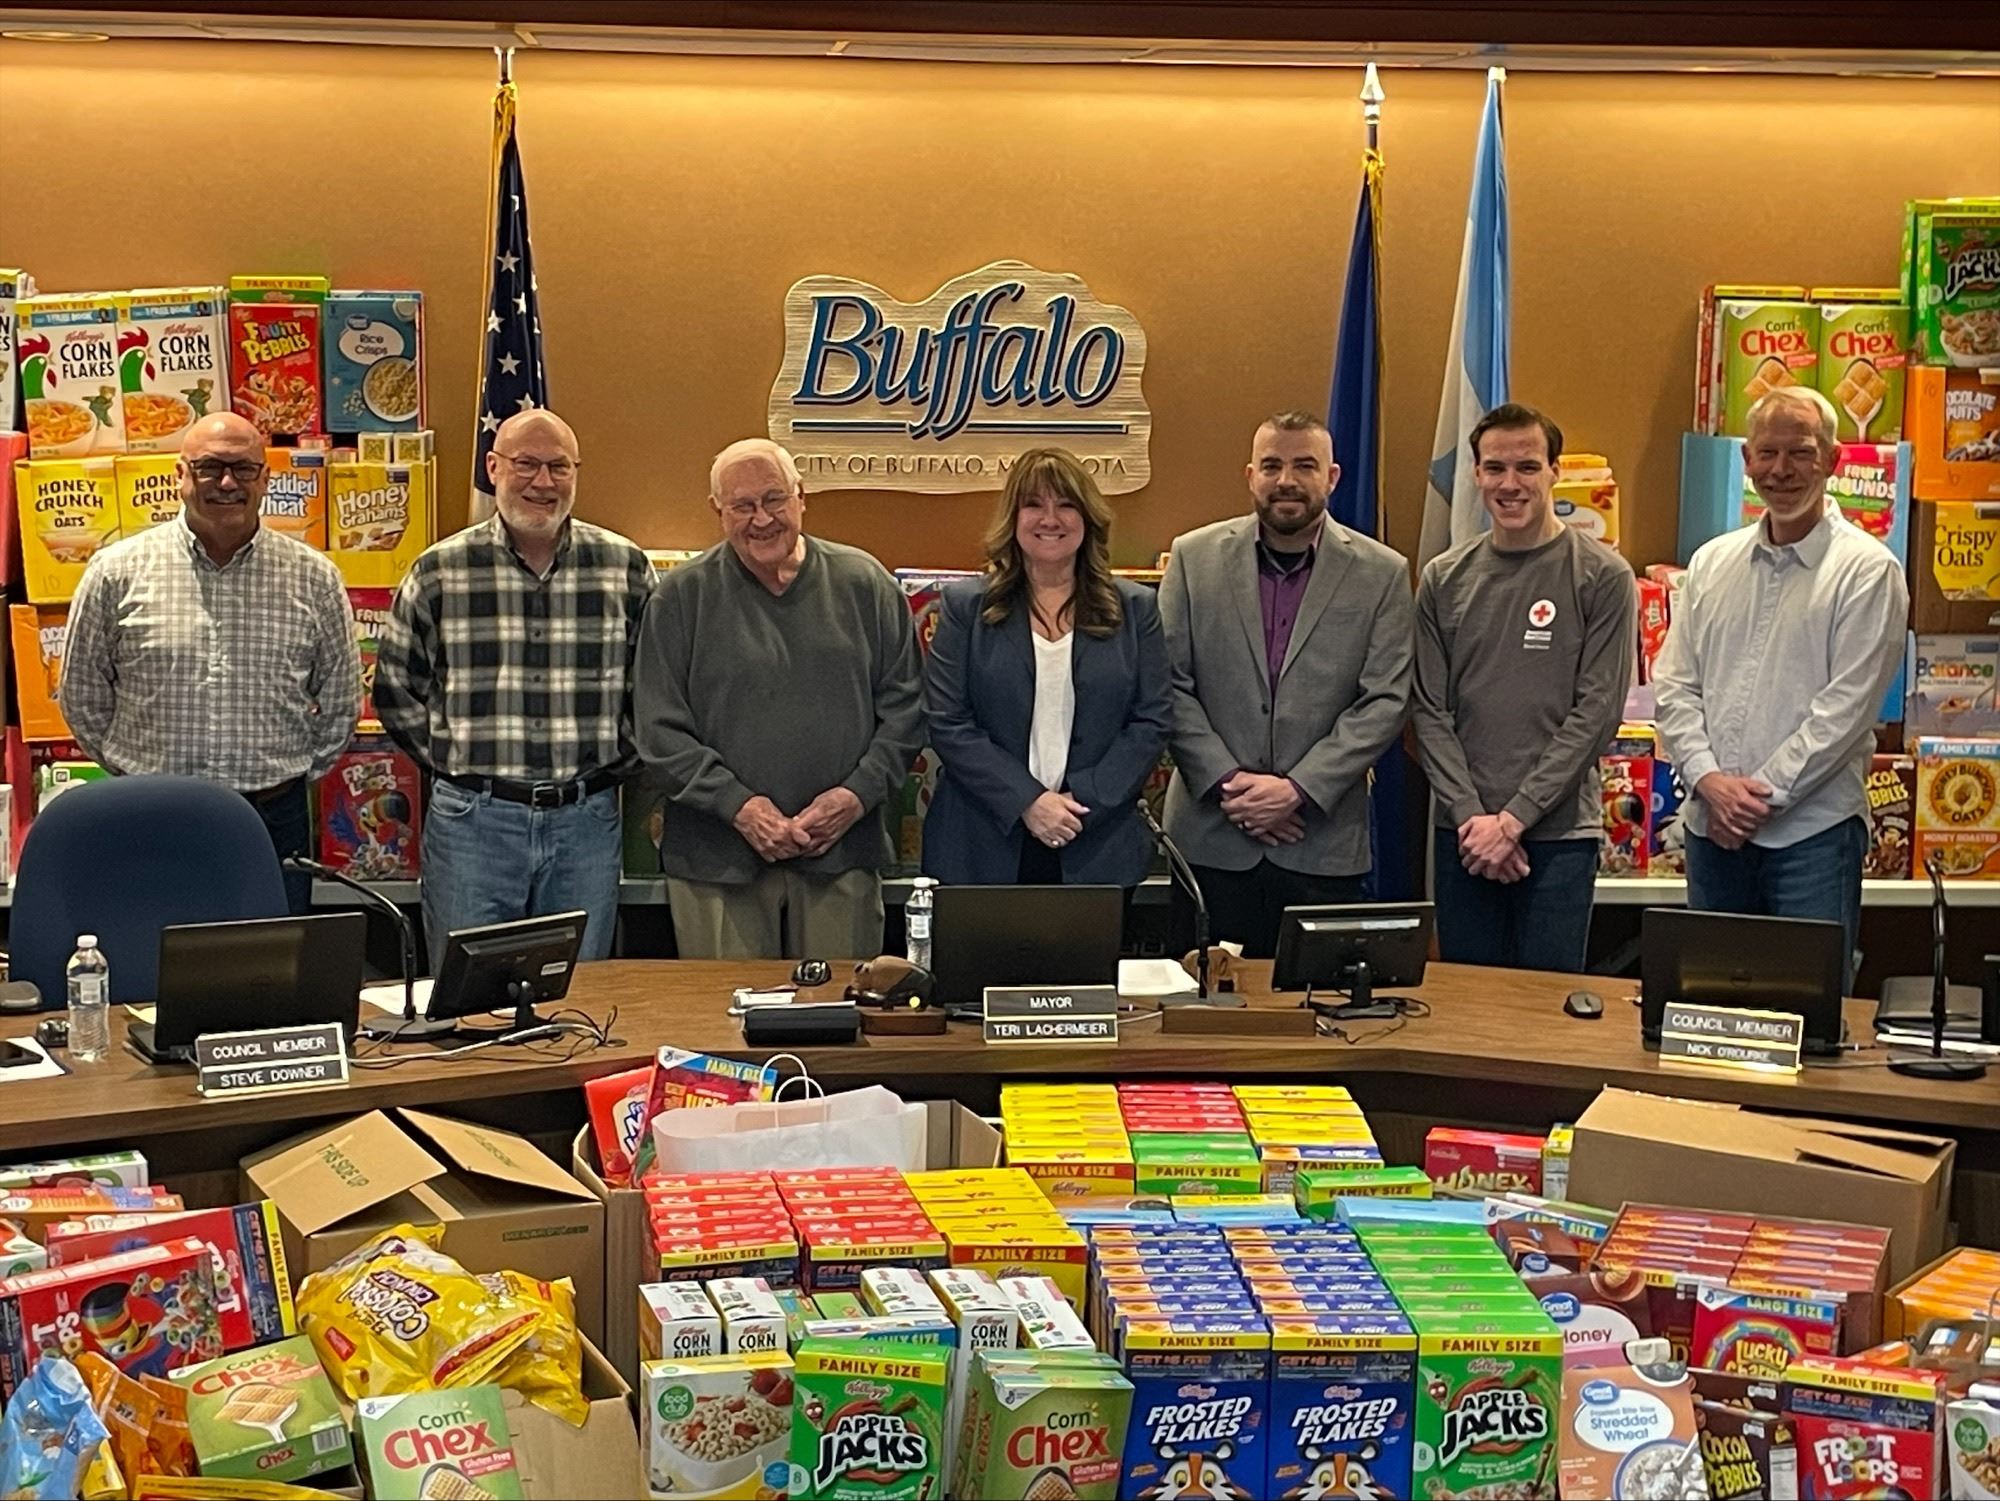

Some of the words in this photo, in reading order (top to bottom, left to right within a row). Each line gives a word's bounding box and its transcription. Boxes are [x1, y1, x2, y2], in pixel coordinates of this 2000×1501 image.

[1765, 321, 1796, 333] Corn
[1854, 322, 1885, 334] Corn
[158, 334, 210, 356] CORN
[241, 332, 311, 365] PEBBLES
[359, 333, 384, 344] Rice
[1739, 330, 1809, 357] Chex
[1829, 331, 1895, 358] Chex
[60, 341, 112, 363] CORN
[791, 282, 1125, 440] Buffalo
[62, 360, 115, 380] FLAKES
[160, 353, 213, 373] FLAKES
[793, 455, 841, 474] CITY
[848, 455, 878, 474] OF
[1844, 464, 1886, 480] FRUIT
[38, 479, 97, 497] HONEY
[135, 473, 179, 492] HON
[267, 471, 317, 497] edded
[35, 494, 104, 512] CRUNCH
[132, 488, 181, 508] CRUN
[336, 484, 409, 514] Honey
[54, 516, 85, 529] OATS
[339, 505, 406, 529] Grahams
[1934, 523, 1997, 550] Crispy
[1937, 547, 1984, 568] Oats
[1916, 657, 1994, 678] Balance
[1933, 743, 1973, 754] FAMILY
[1974, 745, 1997, 754] SIZE
[341, 758, 394, 785] FROOT
[1866, 768, 1901, 789] COA
[349, 774, 397, 797] LOOPS
[1868, 783, 1909, 808] BBLES
[1951, 808, 1985, 822] OATS
[1029, 996, 1073, 1009] MAYOR
[993, 1024, 1021, 1036] TERI
[1026, 1022, 1109, 1036] LACHERMEIER
[1671, 1013, 1728, 1032] COUNCIL
[1735, 1020, 1793, 1038] MEMBER
[211, 1042, 267, 1060] COUNCIL
[273, 1036, 327, 1054] MEMBER
[1686, 1042, 1713, 1056] NICK
[220, 1070, 265, 1088] STEVE
[270, 1065, 326, 1083] DOWNER
[705, 1058, 743, 1079] FAMILY
[332, 1157, 359, 1180] SIDE
[349, 1172, 370, 1188] UP
[1029, 1165, 1080, 1177] FAMILY
[1084, 1165, 1115, 1177] SIZE
[1156, 1167, 1206, 1177] FAMILY
[1210, 1167, 1241, 1177] SIZE
[1329, 1187, 1376, 1198] FAMILY
[1382, 1186, 1413, 1196] SIZE
[694, 1250, 736, 1264] FAMILY
[740, 1248, 766, 1260] SIZE
[844, 1247, 886, 1258] FAMILY
[888, 1246, 914, 1256] SIZE
[973, 1248, 1030, 1261] FAMILY
[1032, 1248, 1067, 1261] SIZE
[269, 1231, 284, 1276] FAMILY
[278, 1276, 290, 1303] SIZE
[1746, 1297, 1790, 1314] LARGE
[1794, 1304, 1825, 1320] SIZE
[673, 1333, 711, 1350] CORN
[738, 1332, 776, 1349] CORN
[971, 1324, 1008, 1339] CORN
[1160, 1336, 1204, 1347] FAMILY
[1208, 1336, 1235, 1347] SIZE
[1306, 1338, 1351, 1348] FAMILY
[1355, 1338, 1382, 1348] SIZE
[1442, 1339, 1500, 1352] FAMILY
[1505, 1340, 1541, 1352] SIZE
[227, 1350, 274, 1371] Corn
[1736, 1339, 1788, 1371] Lucky
[192, 1355, 301, 1395] Chex
[819, 1358, 879, 1375] FAMILY
[884, 1363, 922, 1378] SIZE
[1821, 1374, 1868, 1389] FAMILY
[1871, 1378, 1900, 1393] SIZE
[663, 1393, 689, 1405] food
[1461, 1391, 1525, 1412] APPLE
[418, 1409, 466, 1431] Corn
[664, 1404, 688, 1417] club
[1047, 1410, 1091, 1430] Corn
[1146, 1396, 1252, 1426] FROSTED
[1291, 1397, 1398, 1428] FROSTED
[836, 1415, 905, 1436] APPLE
[1151, 1416, 1242, 1445] FLAKES
[1297, 1417, 1388, 1446] FLAKES
[1590, 1413, 1659, 1430] Shredded
[1441, 1408, 1545, 1460] JACKS
[1603, 1427, 1649, 1442] Wheat
[384, 1420, 497, 1471] Chex
[1007, 1424, 1111, 1469] Chex
[1701, 1429, 1753, 1462] COCOA
[1813, 1434, 1897, 1466] FROOT
[256, 1445, 296, 1471] Chex
[463, 1453, 492, 1469] Gluten
[816, 1431, 924, 1486] JACKS
[1072, 1464, 1098, 1476] Gluten
[1705, 1461, 1762, 1498] PEBBLES
[1823, 1458, 1899, 1487] LOOPS
